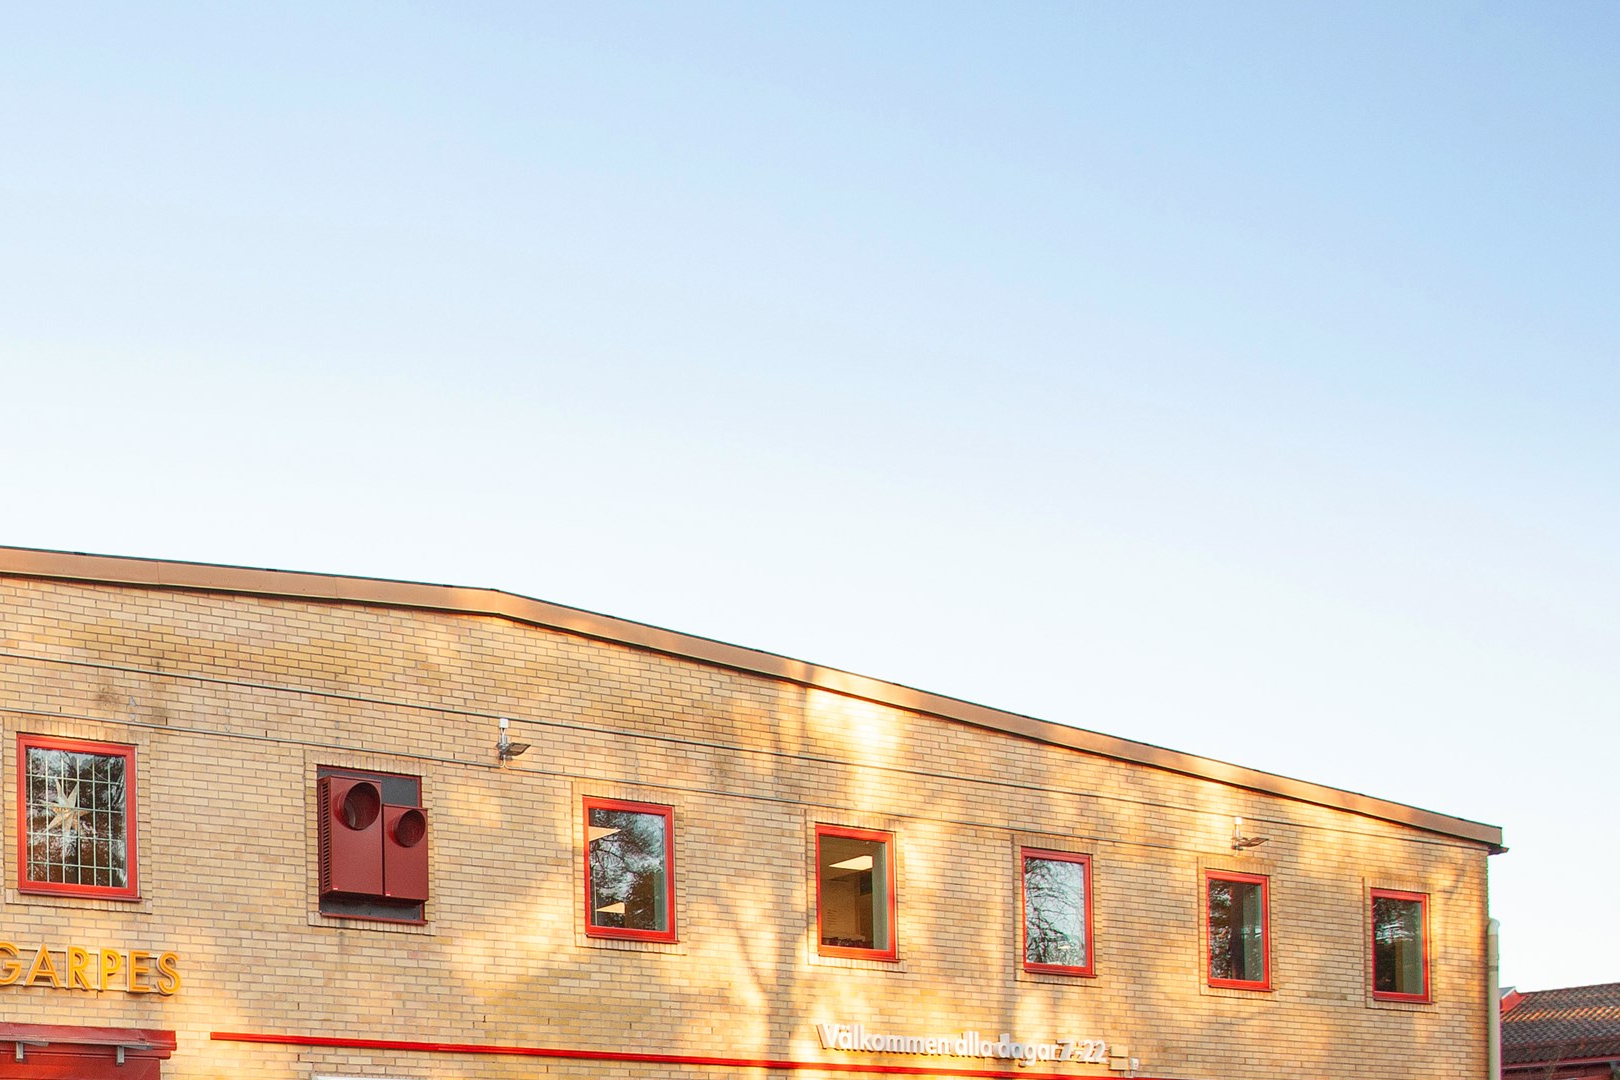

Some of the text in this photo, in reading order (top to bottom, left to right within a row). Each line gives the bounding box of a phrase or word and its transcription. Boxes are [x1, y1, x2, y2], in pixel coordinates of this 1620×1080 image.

[816, 1023, 1108, 1067] Välkommen alla dagar 7-22
